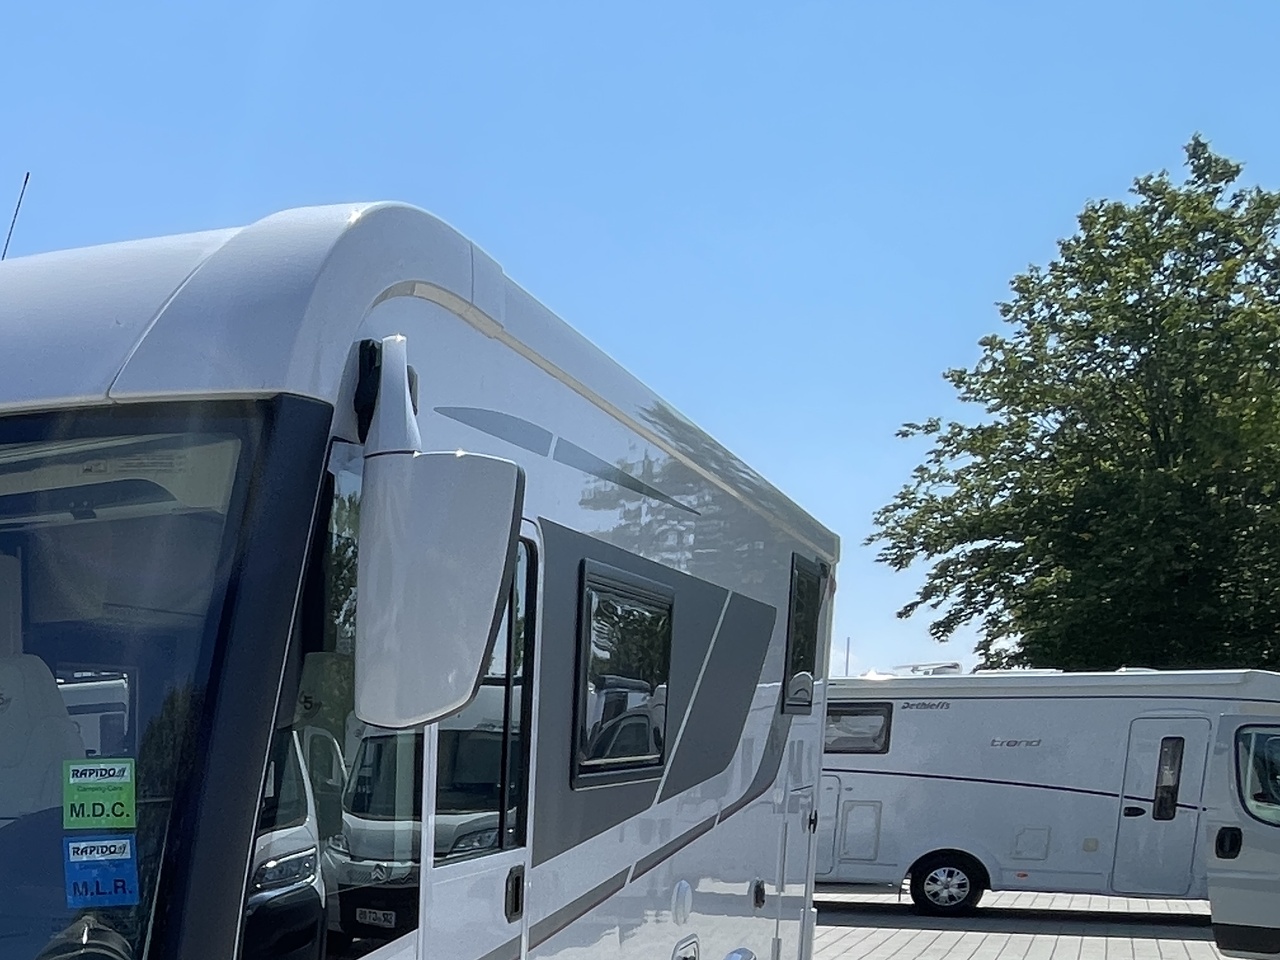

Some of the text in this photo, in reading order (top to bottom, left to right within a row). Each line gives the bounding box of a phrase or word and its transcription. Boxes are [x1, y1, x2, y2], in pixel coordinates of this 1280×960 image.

[71, 767, 116, 779] RAPIDO
[70, 802, 130, 818] M.D.C.
[72, 844, 117, 857] RAPIDO
[72, 879, 133, 897] M.L.R.
